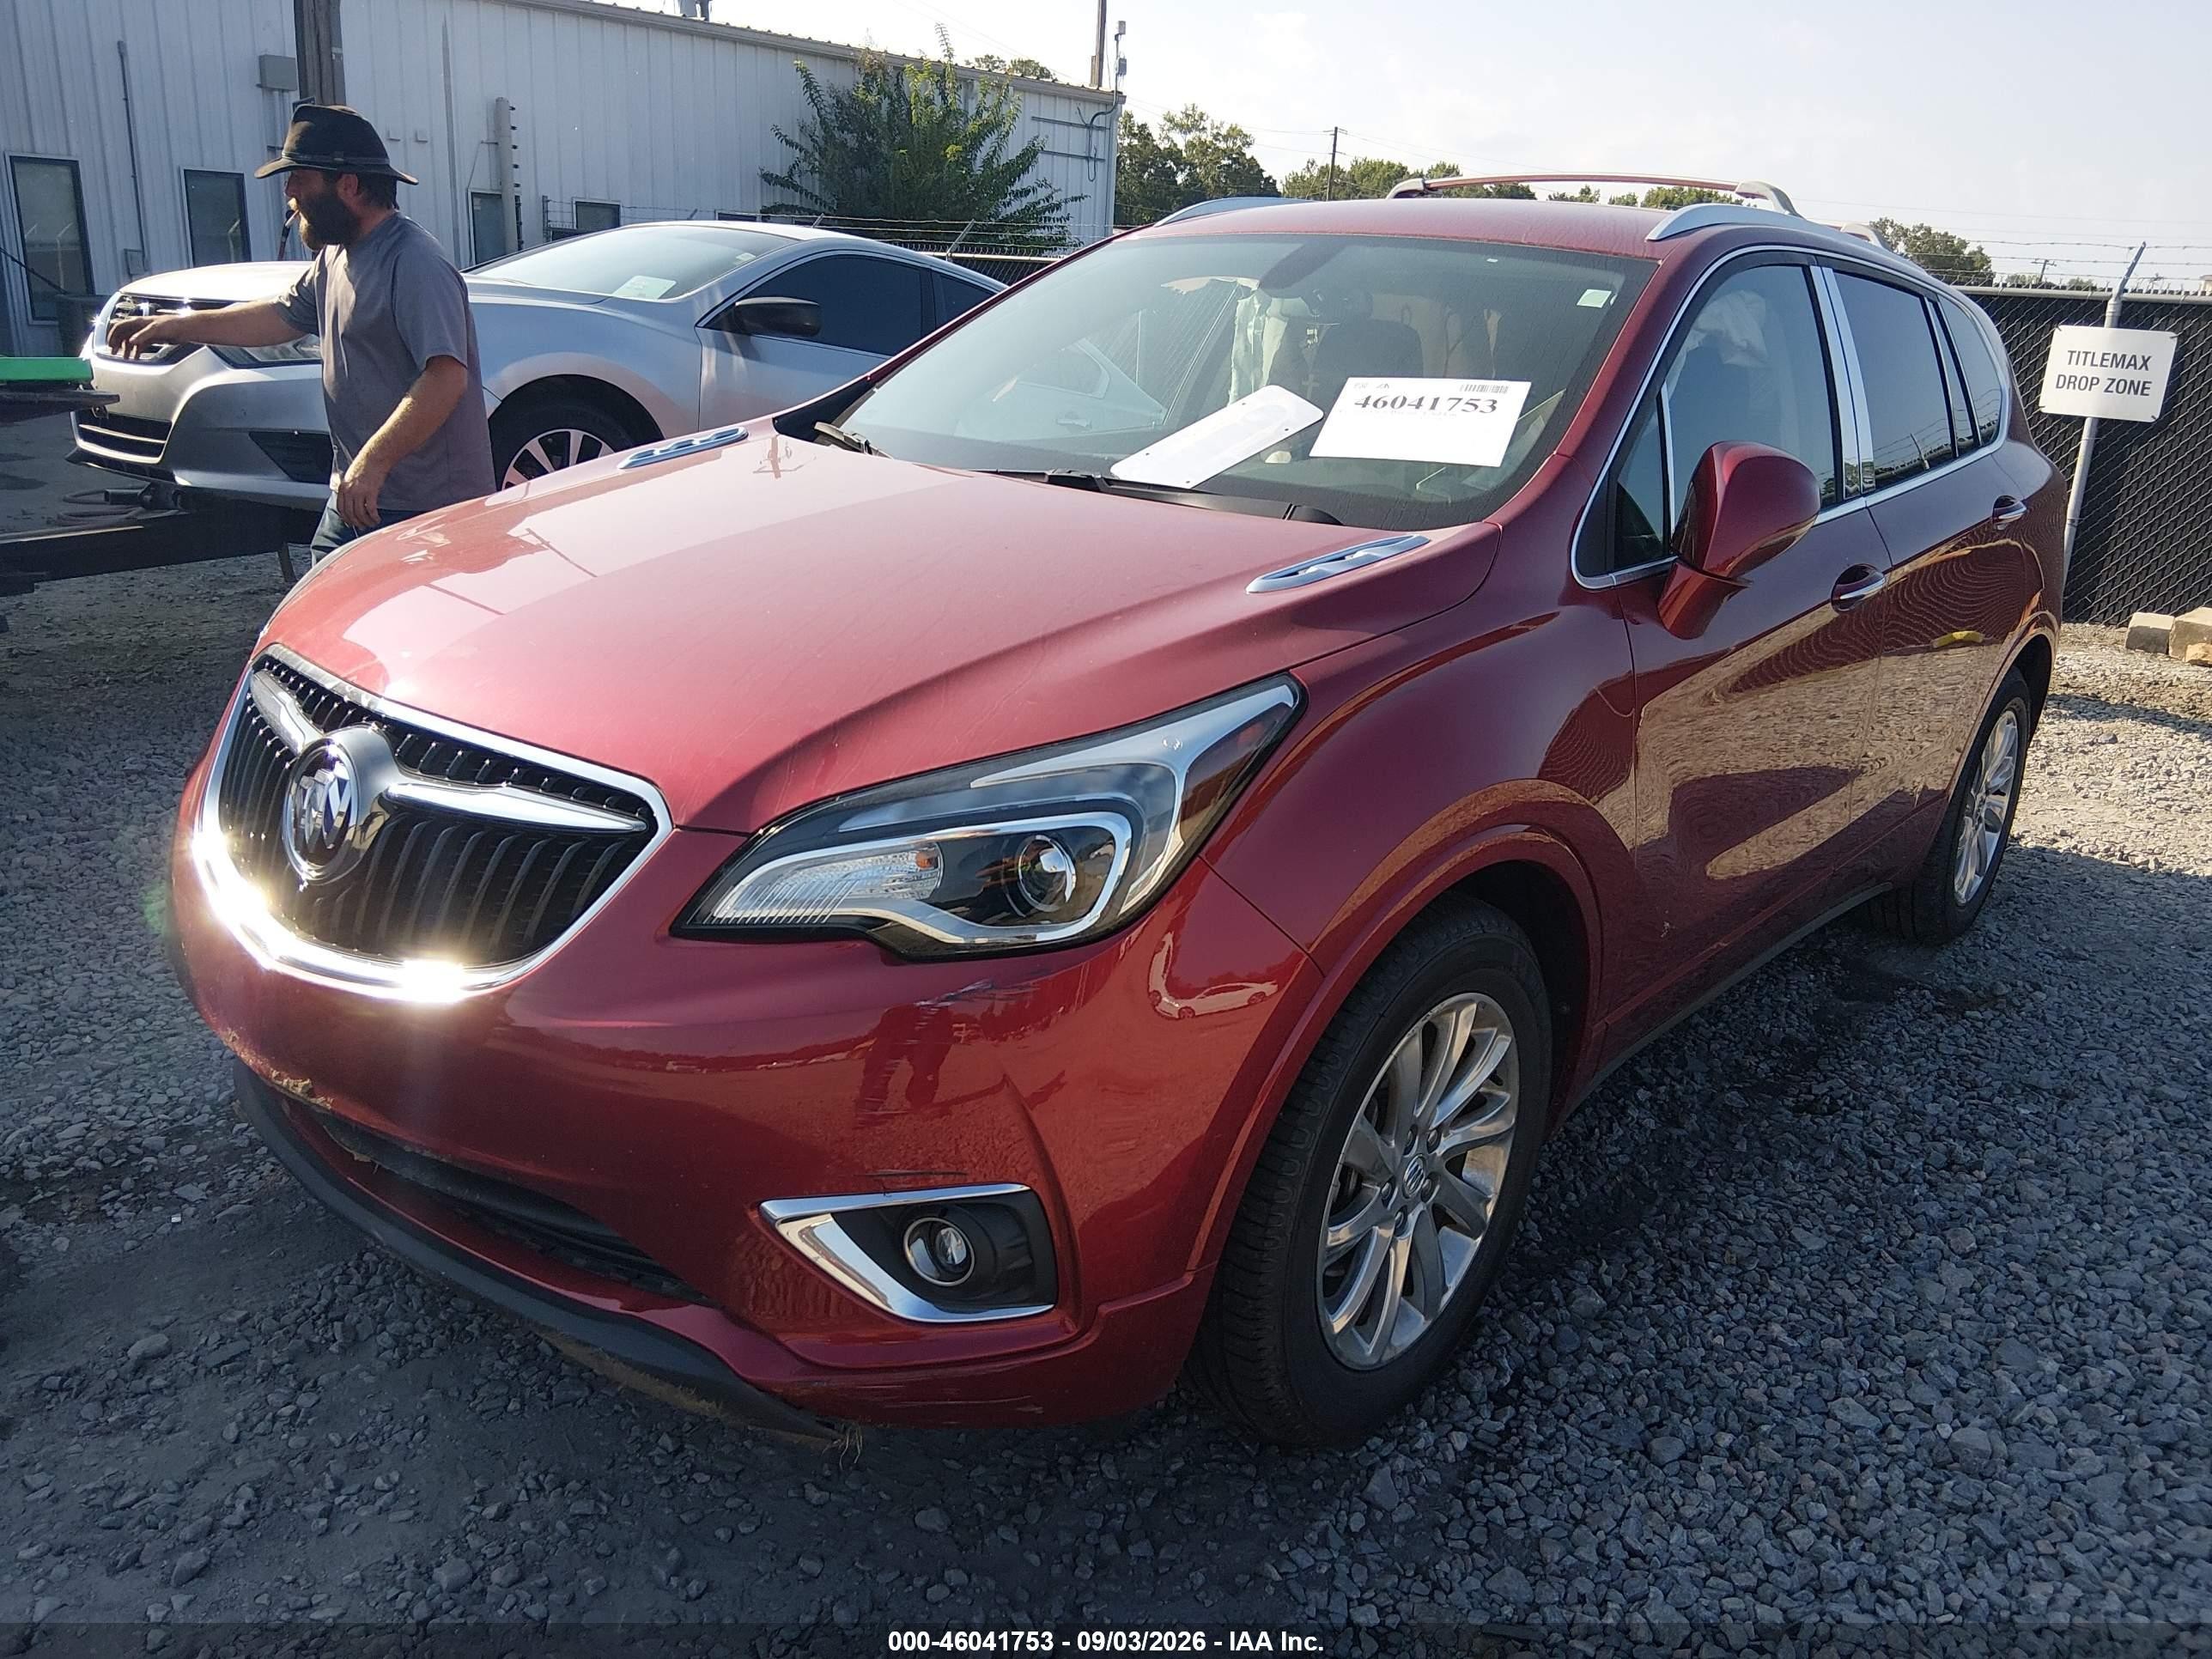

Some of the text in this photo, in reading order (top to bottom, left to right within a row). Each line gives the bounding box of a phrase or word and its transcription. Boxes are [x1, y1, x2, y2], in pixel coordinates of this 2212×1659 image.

[2067, 350, 2152, 371] TITLEMAX
[2055, 374, 2153, 396] DROP ZONE
[1354, 395, 1498, 413] 46041753
